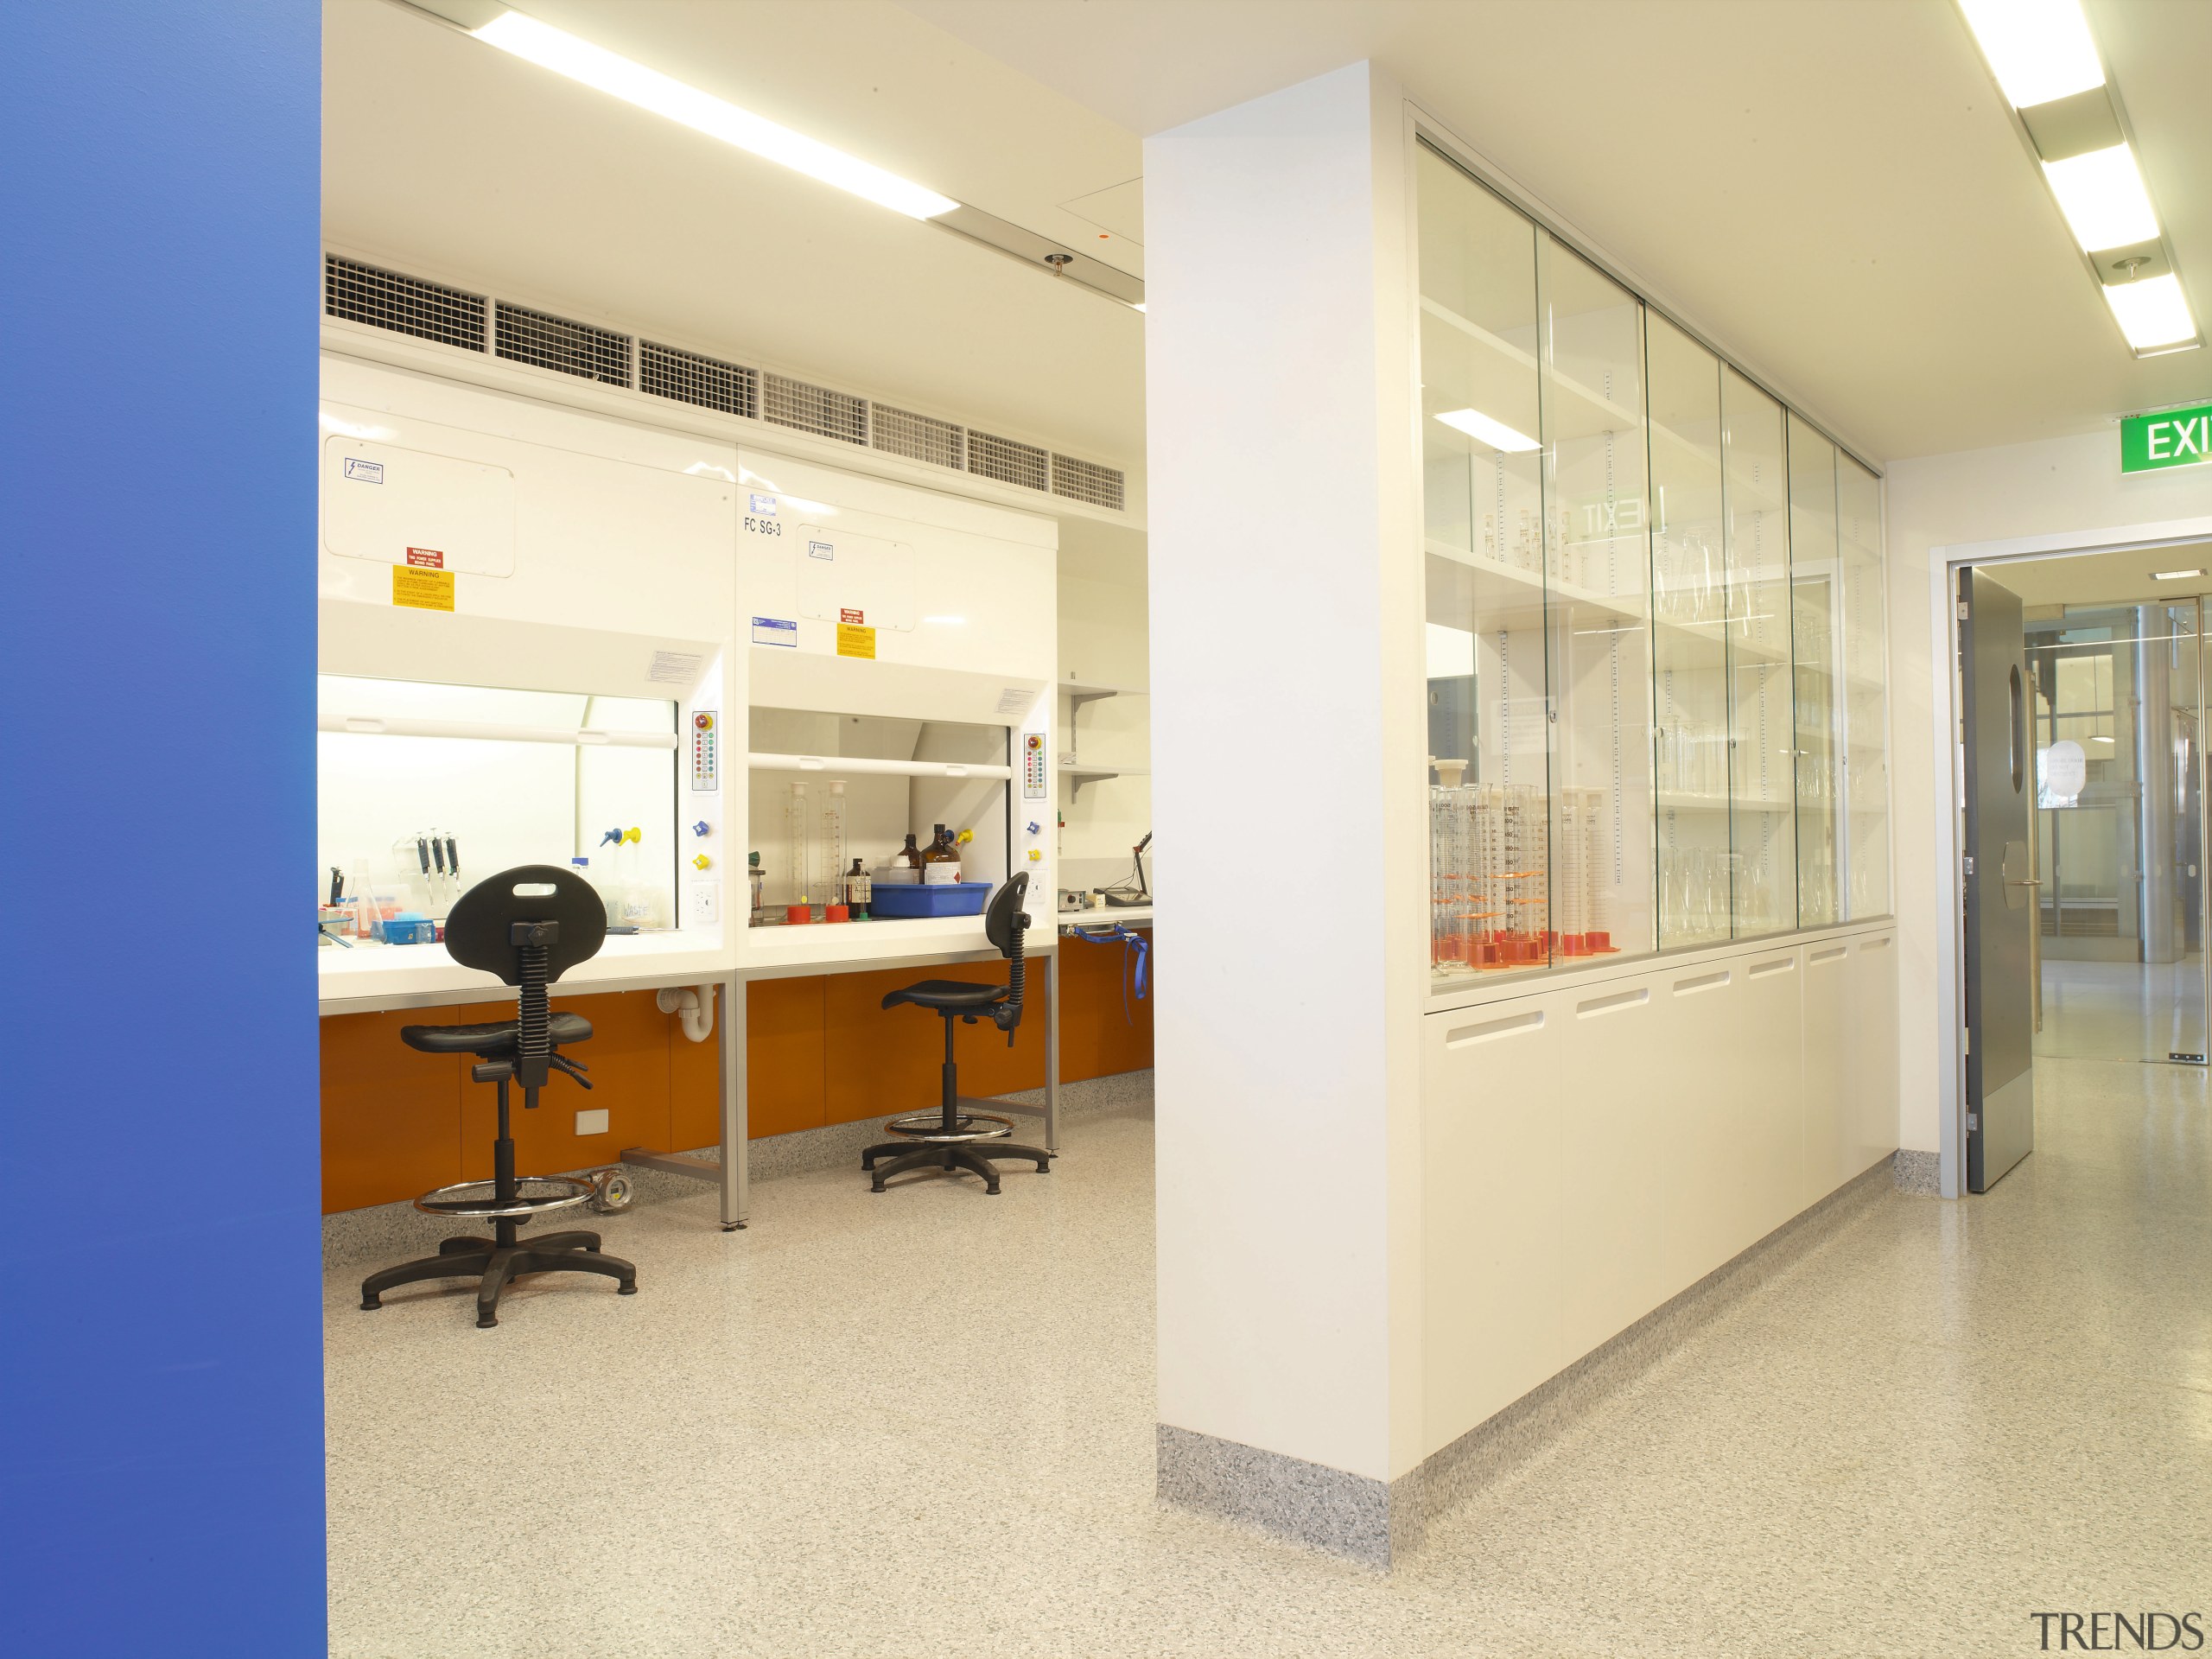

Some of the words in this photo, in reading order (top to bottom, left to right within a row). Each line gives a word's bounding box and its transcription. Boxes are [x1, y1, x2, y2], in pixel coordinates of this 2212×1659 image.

[2147, 416, 2212, 461] EXI
[744, 517, 756, 532] FC
[760, 519, 781, 537] SG-3
[409, 569, 440, 578] WARNING
[623, 902, 649, 918] WASTE
